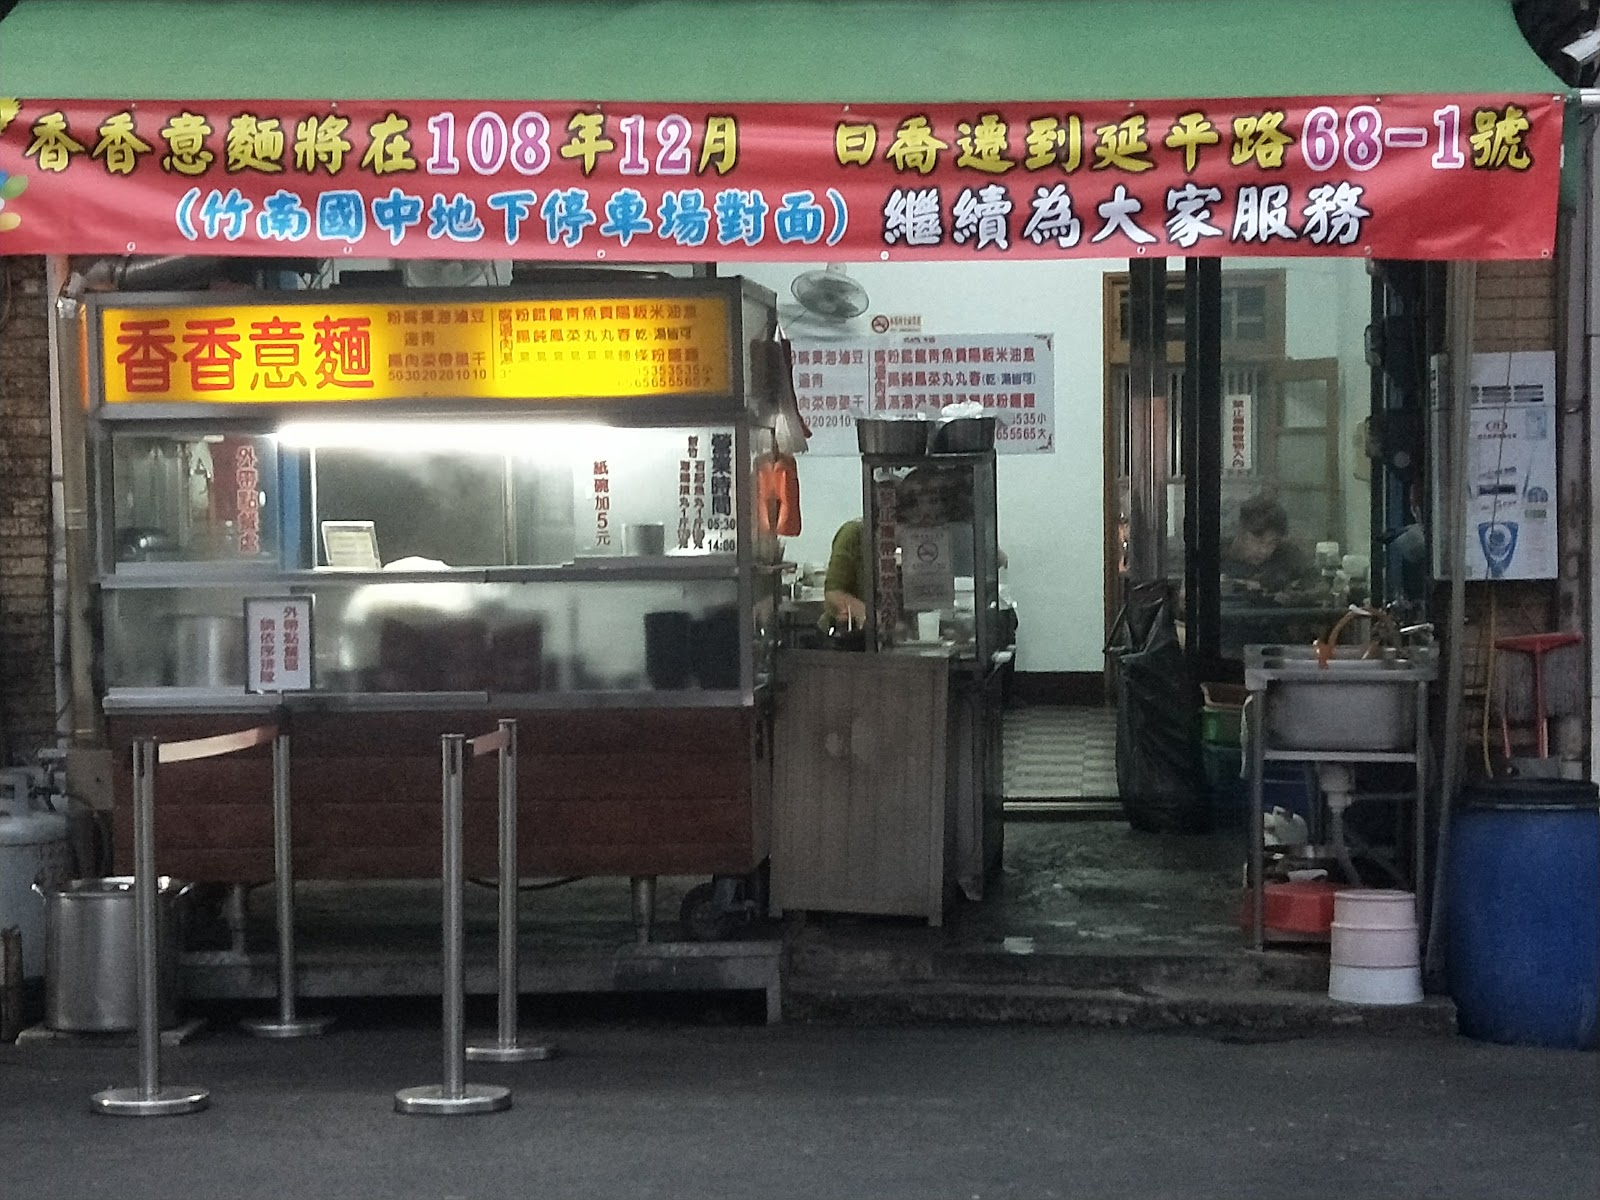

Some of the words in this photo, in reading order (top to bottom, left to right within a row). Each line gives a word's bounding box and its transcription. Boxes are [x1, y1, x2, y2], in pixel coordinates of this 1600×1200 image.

[882, 182, 1370, 249] 繼續為大家服務
[117, 315, 375, 393] 香香意麵
[593, 460, 611, 546] 紙碗加5元
